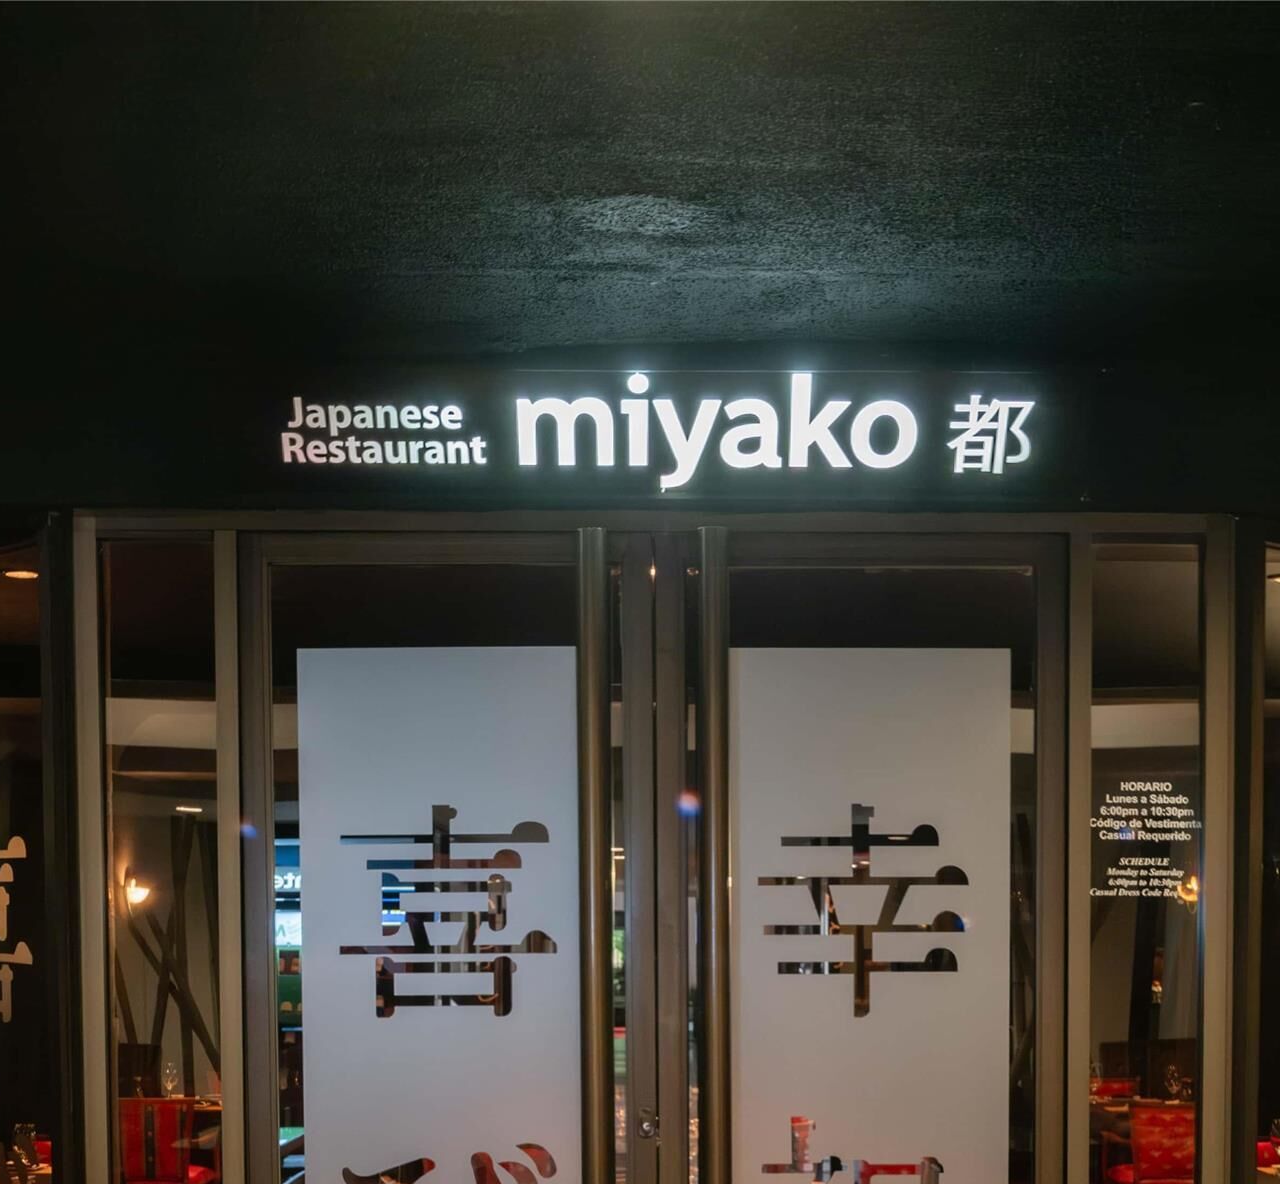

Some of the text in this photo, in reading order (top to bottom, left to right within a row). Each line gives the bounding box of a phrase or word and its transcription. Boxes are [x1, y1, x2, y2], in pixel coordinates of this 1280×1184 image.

[287, 396, 464, 437] Japanese
[516, 372, 918, 492] miyako
[946, 394, 1036, 475] 都
[280, 431, 488, 465] Restaurant
[1120, 782, 1173, 792] HORARIO
[1105, 794, 1189, 805] Lunes a Sábado
[1100, 806, 1195, 818] 6:00pm a 10:30pm
[1089, 817, 1202, 830] Código de Vestimenta
[1099, 830, 1192, 842] Casual Requerido
[1118, 857, 1170, 867] SCHEDULE
[1106, 867, 1185, 878] Monday to Saturday
[1089, 888, 1117, 897] Casual
[1118, 888, 1140, 897] Dress
[1141, 888, 1163, 897] Code
